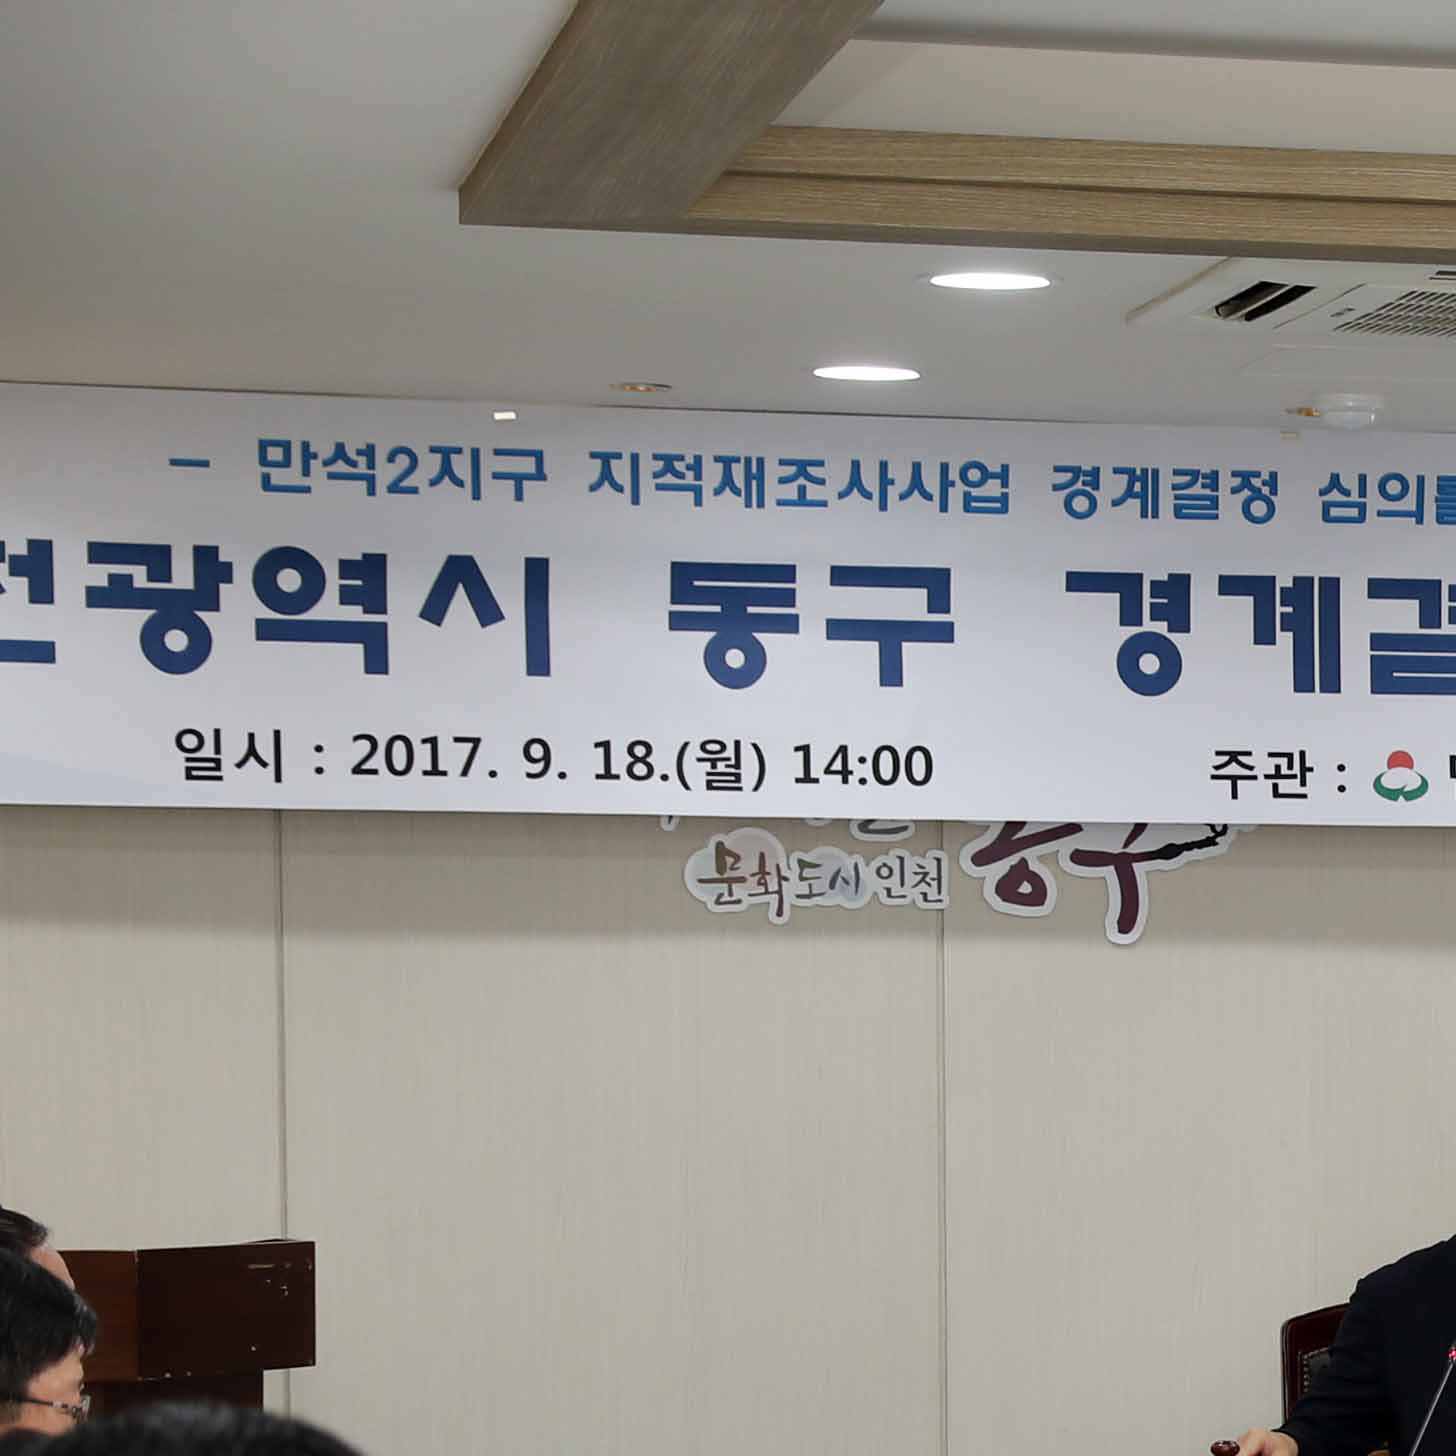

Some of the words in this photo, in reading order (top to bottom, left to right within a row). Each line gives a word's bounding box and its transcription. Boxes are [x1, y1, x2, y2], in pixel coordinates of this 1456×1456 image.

[257, 438, 548, 502] 만석2지구
[588, 450, 1010, 515] 지적재조사사업
[1051, 465, 1279, 525] 경계결정
[668, 560, 955, 690] 동구
[174, 727, 283, 784] 일시
[351, 733, 498, 779] 2017.
[522, 737, 568, 780] 9.
[593, 739, 766, 793] 18.(월)
[793, 743, 934, 787] 14:00
[1210, 749, 1315, 801] 주관
